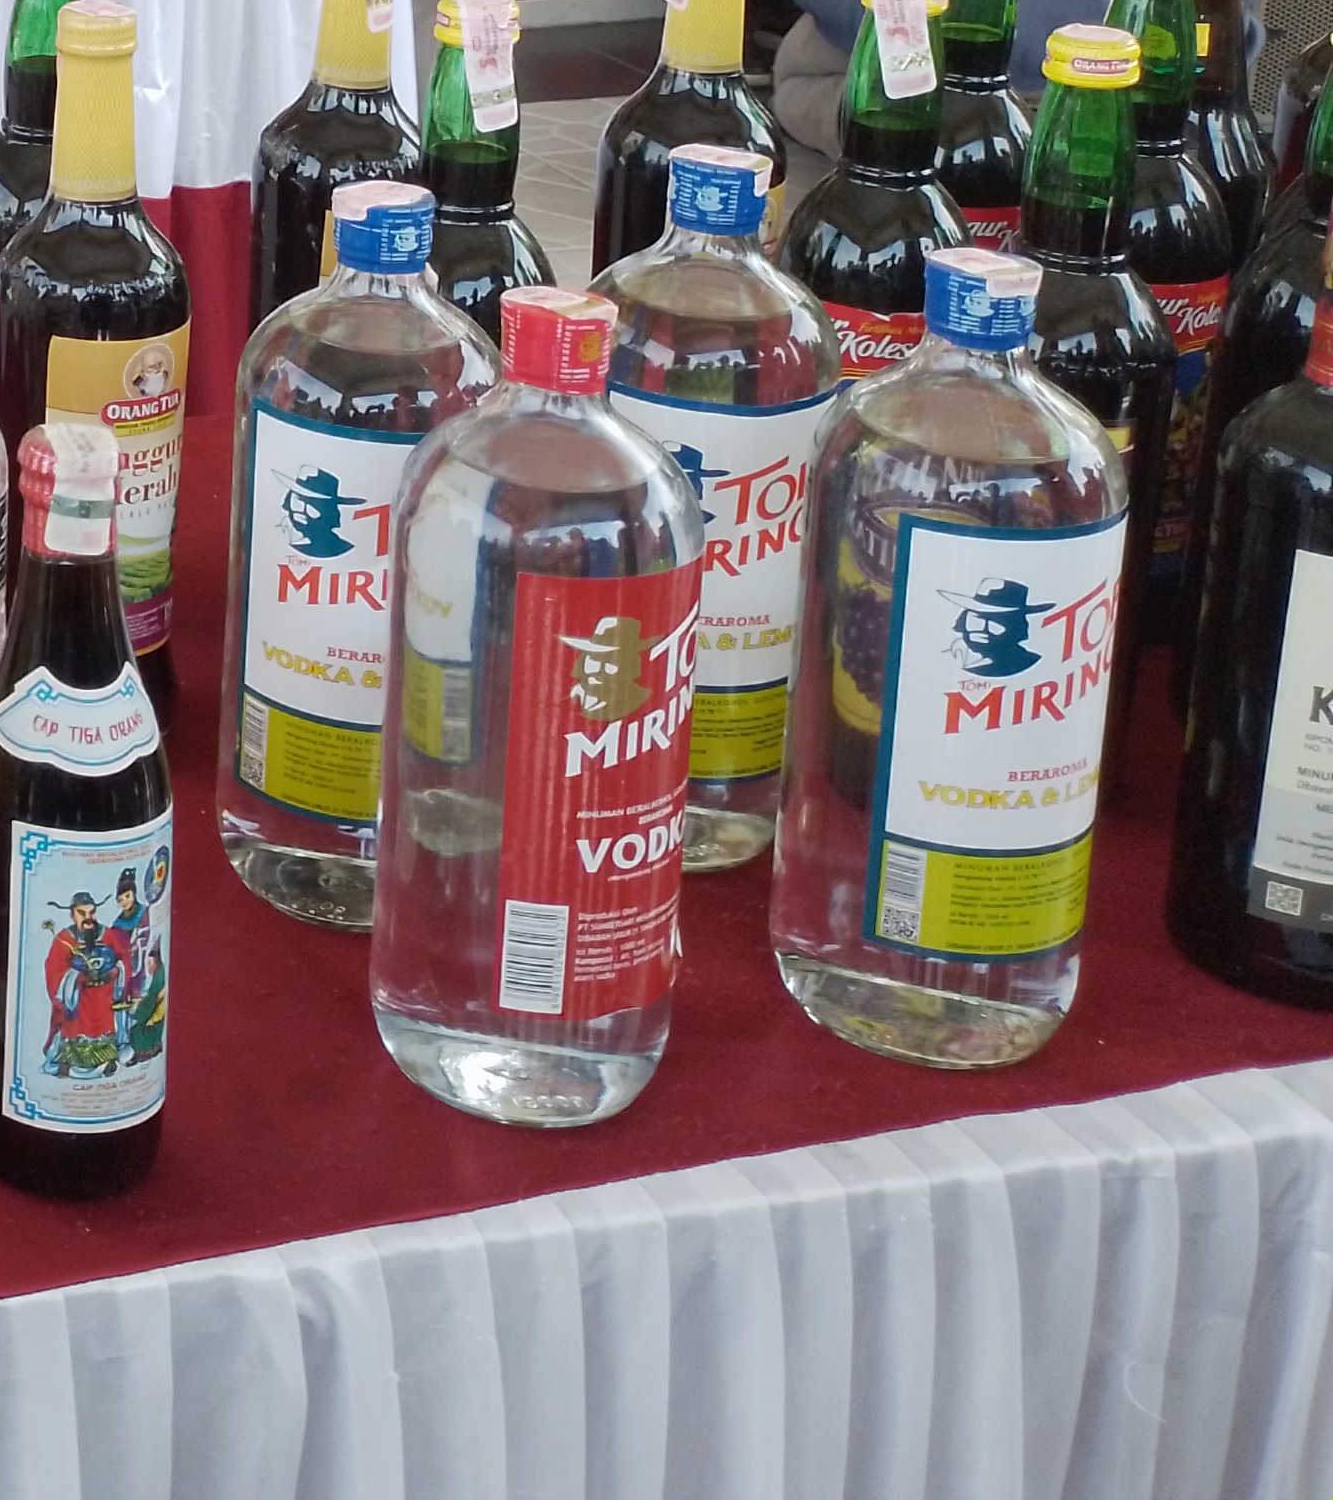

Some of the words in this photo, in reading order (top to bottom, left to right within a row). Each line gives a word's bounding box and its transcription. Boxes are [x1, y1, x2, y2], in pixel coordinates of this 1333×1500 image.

[836, 330, 921, 364] Koles
[106, 401, 159, 421] ORANG
[160, 391, 180, 411] TUA
[116, 464, 179, 506] erah
[277, 563, 388, 612] MIRI
[261, 641, 355, 686] VODKA
[326, 647, 382, 664] BERAR
[943, 642, 1111, 735] MIRIN
[957, 679, 992, 691] TOMI
[32, 714, 59, 737] CAP
[68, 725, 104, 745] TIGA
[564, 673, 694, 778] MIRIN
[1006, 757, 1088, 783] BERAROMA
[917, 779, 1036, 810] VODKA
[575, 808, 684, 874] VODK
